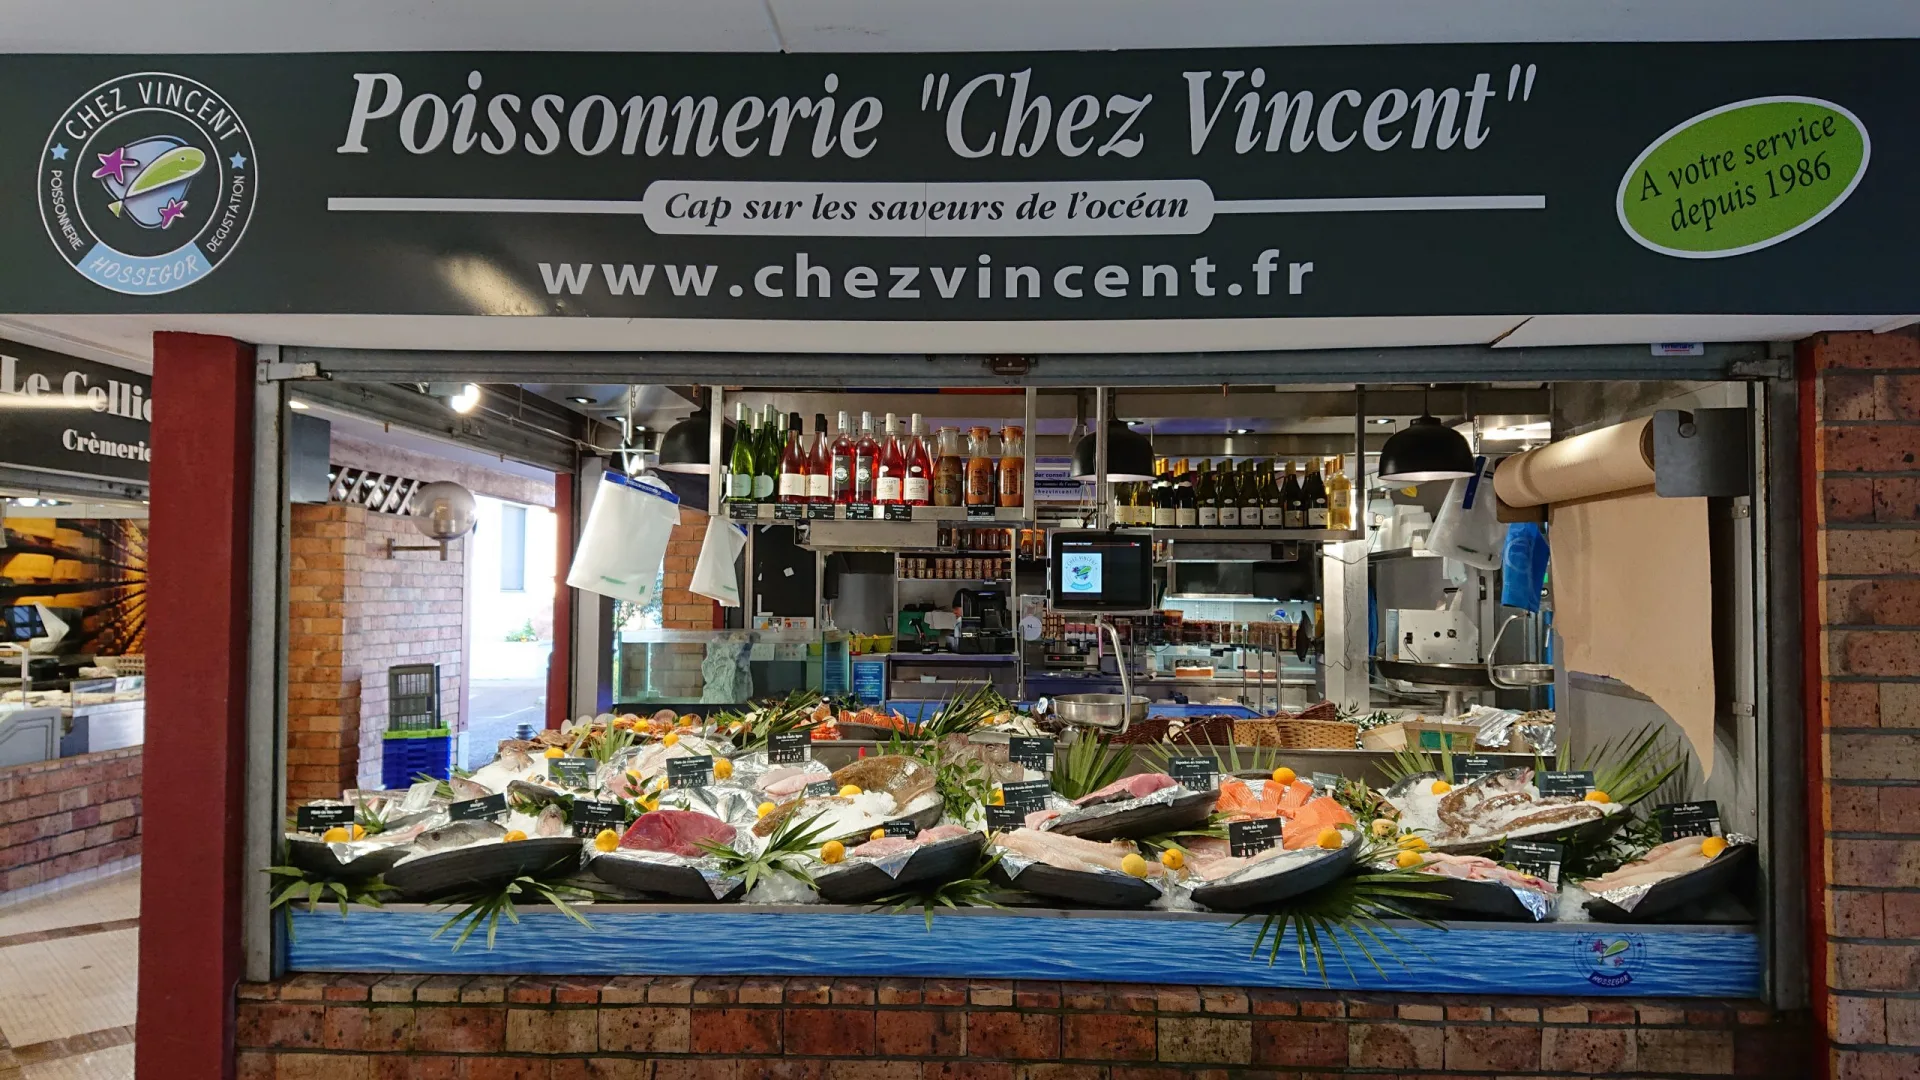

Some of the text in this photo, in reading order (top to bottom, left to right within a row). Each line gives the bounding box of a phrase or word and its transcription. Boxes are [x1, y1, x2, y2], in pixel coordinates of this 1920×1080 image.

[65, 82, 241, 141] CHEZ VINCENT
[337, 64, 1537, 159] Poissonnerie "Chez Vincent"
[1640, 115, 1837, 201] A votre service
[51, 169, 84, 251] POISSONNERIE
[206, 175, 246, 253] DEGUSTATION
[664, 191, 1190, 228] Cap sur les saveurs de l’océan
[1671, 150, 1832, 233] depuis 1986
[89, 254, 199, 286] HOSSEGOR
[538, 248, 1314, 299] www.chezvincent.fr
[0, 353, 51, 400] Le
[1592, 974, 1629, 986] HOSSEGOR
